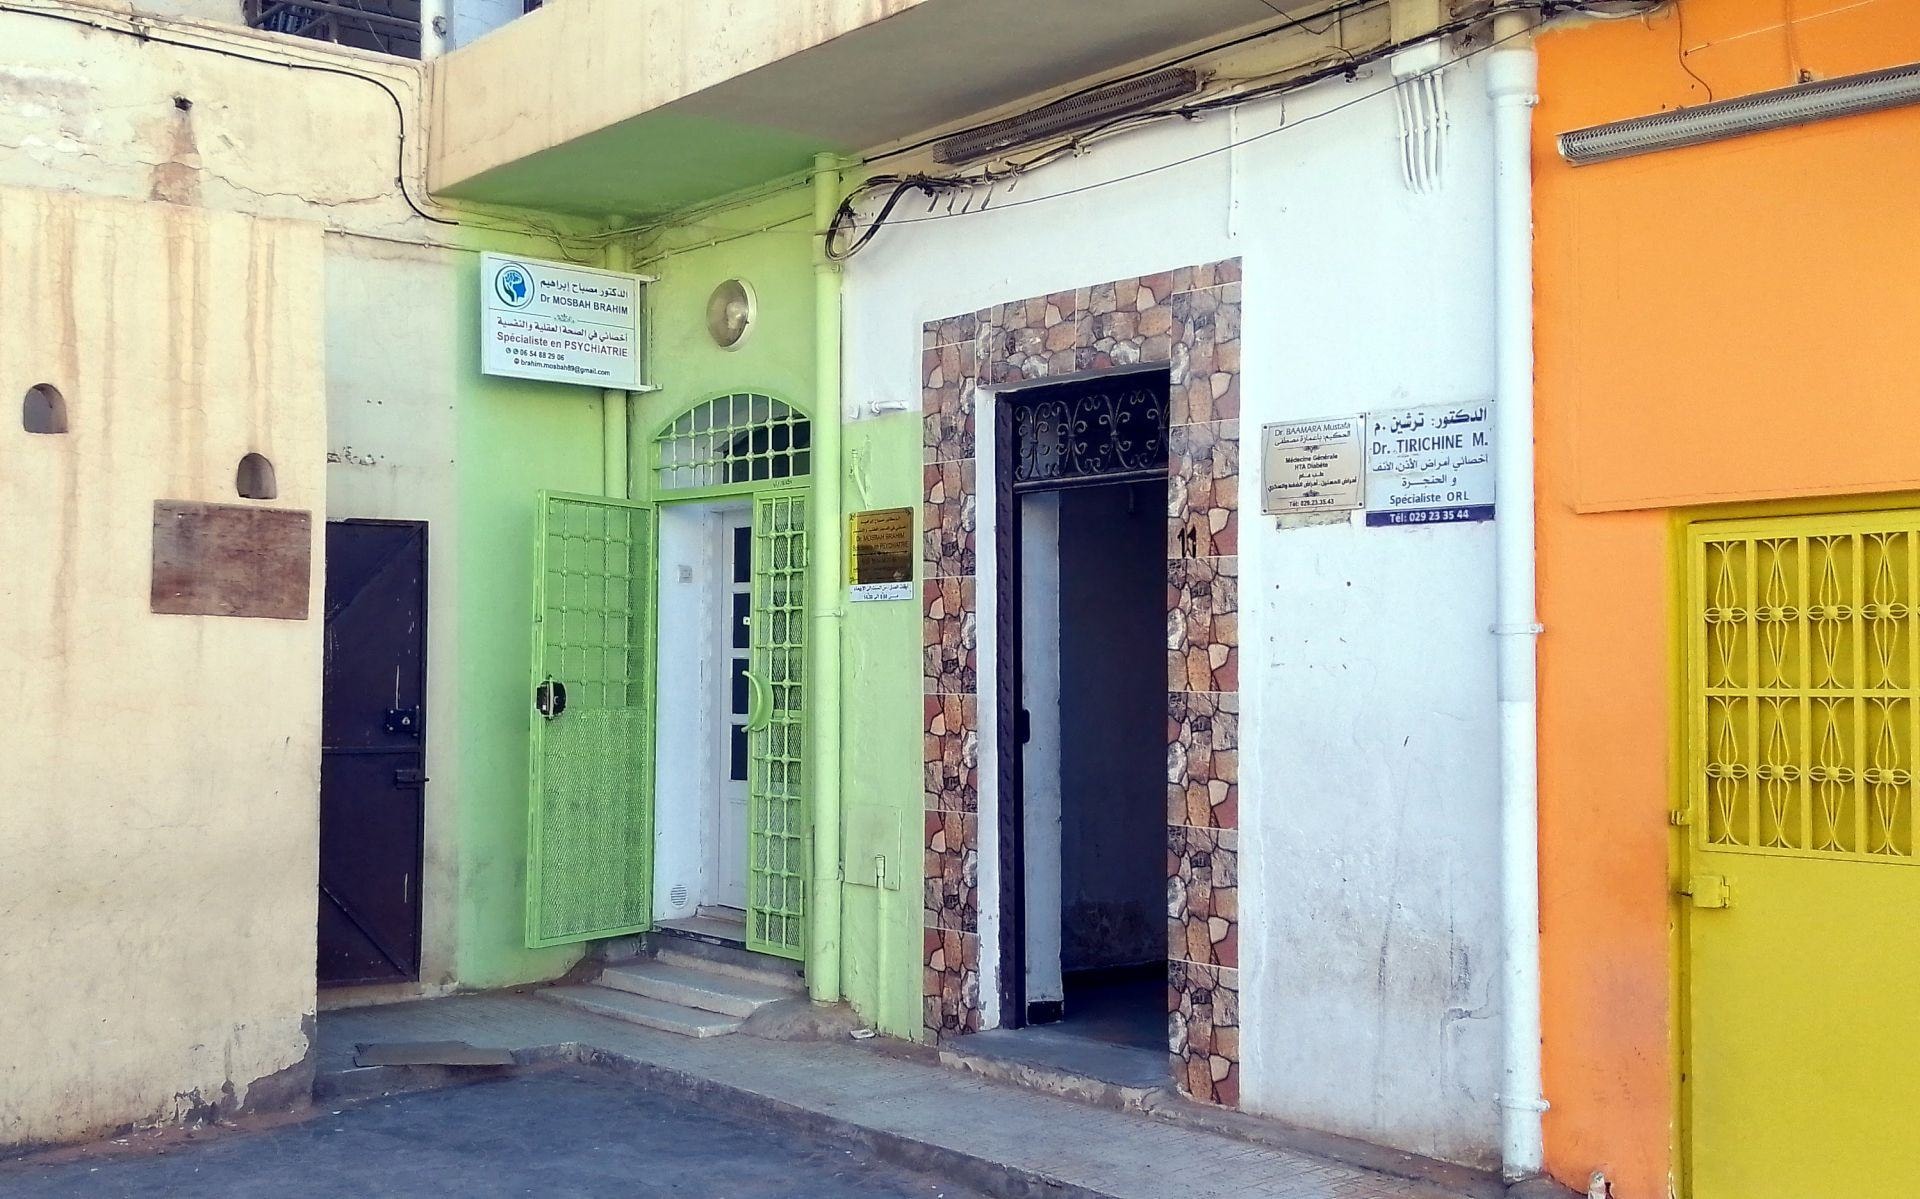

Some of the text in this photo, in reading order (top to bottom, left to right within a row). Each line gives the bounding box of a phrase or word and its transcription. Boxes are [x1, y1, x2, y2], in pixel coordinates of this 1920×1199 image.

[540, 280, 628, 298] الدكتور مصباح إبراهيم
[540, 294, 628, 315] Dr MOSBAH BRAHIM
[562, 326, 587, 336] الصحة
[588, 330, 598, 341] في
[497, 331, 548, 346] Spécialiste
[564, 340, 628, 357] PSYCHIATRIE
[538, 351, 547, 359] 88
[547, 352, 556, 360] 29
[1286, 424, 1322, 436] BAAMARA
[1323, 422, 1351, 431] Mustafa
[1390, 412, 1424, 434] ترشين
[1372, 432, 1489, 455] Dr. TIRICHINE M.
[1451, 475, 1457, 487] و
[1389, 491, 1470, 506] Spécialiste ORL
[1389, 509, 1469, 523] Tél: 029 23 35 44
[1177, 525, 1197, 559] 11
